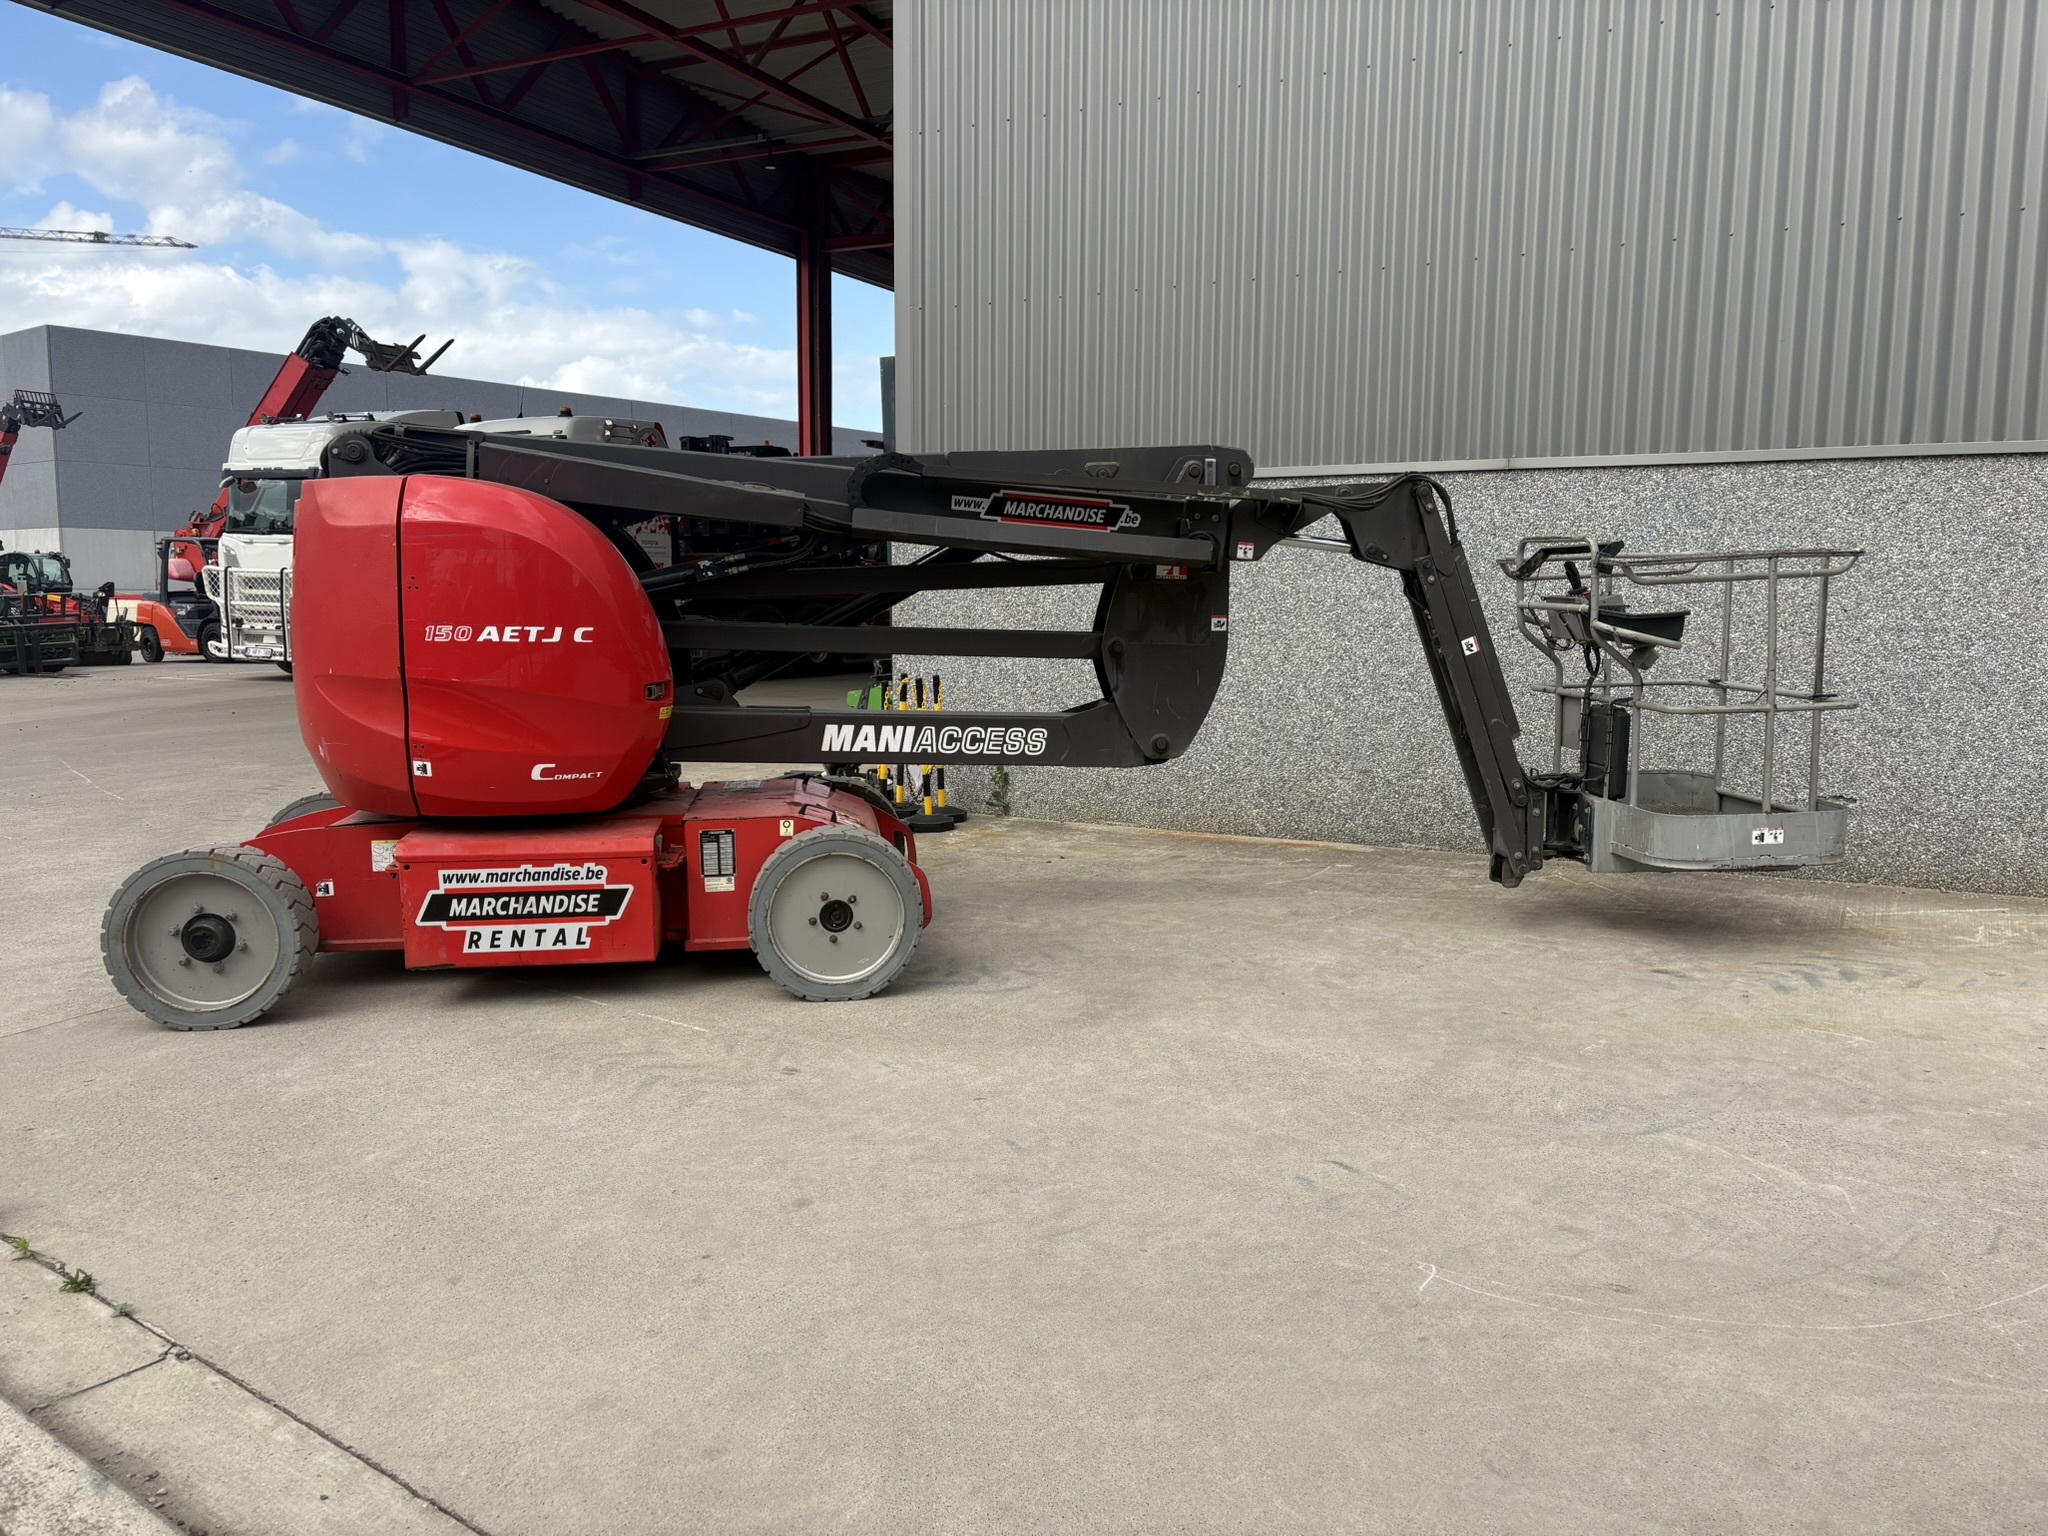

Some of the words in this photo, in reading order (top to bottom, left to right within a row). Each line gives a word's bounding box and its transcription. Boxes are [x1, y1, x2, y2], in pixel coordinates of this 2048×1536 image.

[953, 498, 985, 510] www.
[1003, 500, 1107, 523] MARCHANDISE
[1120, 510, 1139, 525] .be
[424, 625, 473, 642] 150
[476, 626, 563, 643] AETJ
[573, 626, 594, 643] C
[820, 723, 1048, 756] MANIACCESS
[442, 866, 604, 884] www.marchandise.be
[449, 893, 601, 917] MARCHANDISE
[467, 927, 587, 950] RENTAL
